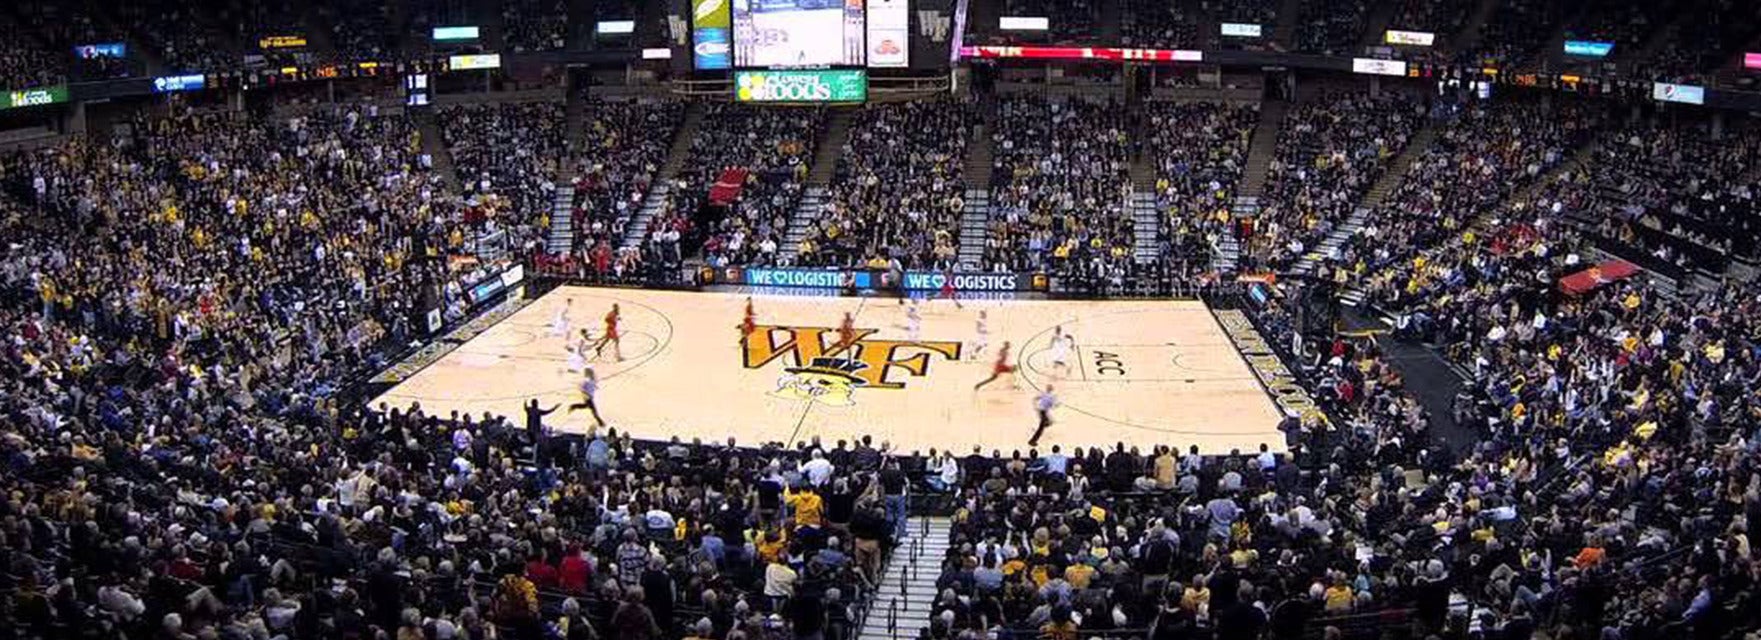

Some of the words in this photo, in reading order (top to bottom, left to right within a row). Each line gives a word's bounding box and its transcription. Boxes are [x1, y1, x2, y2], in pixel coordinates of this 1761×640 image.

[751, 269, 772, 285] WE
[789, 271, 848, 287] LOGISTIC
[909, 274, 930, 289] WE
[1092, 350, 1125, 376] ACC
